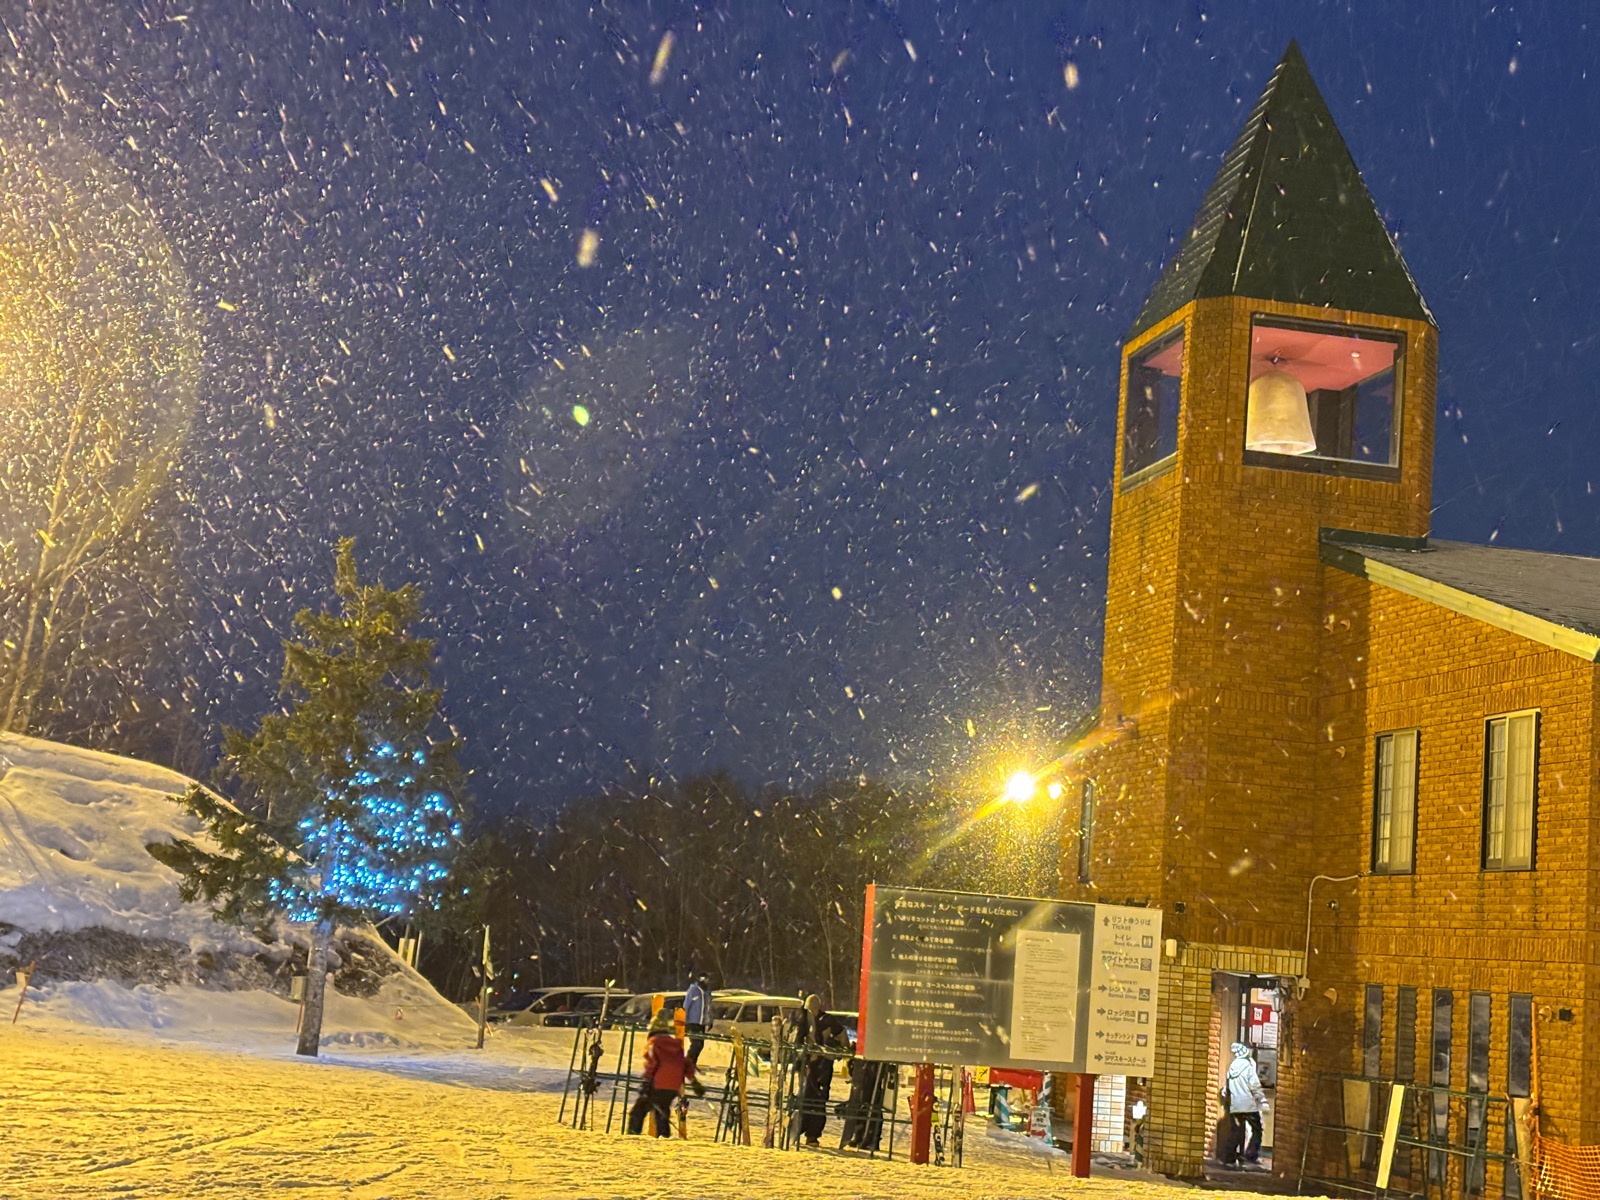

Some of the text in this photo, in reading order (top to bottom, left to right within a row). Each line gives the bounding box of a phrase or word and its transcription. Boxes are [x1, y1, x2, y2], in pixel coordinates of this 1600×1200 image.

[1112, 923, 1131, 931] Ticket
[1101, 955, 1139, 964] ホワイトテラス
[1107, 1009, 1135, 1018] ロッジ売店
